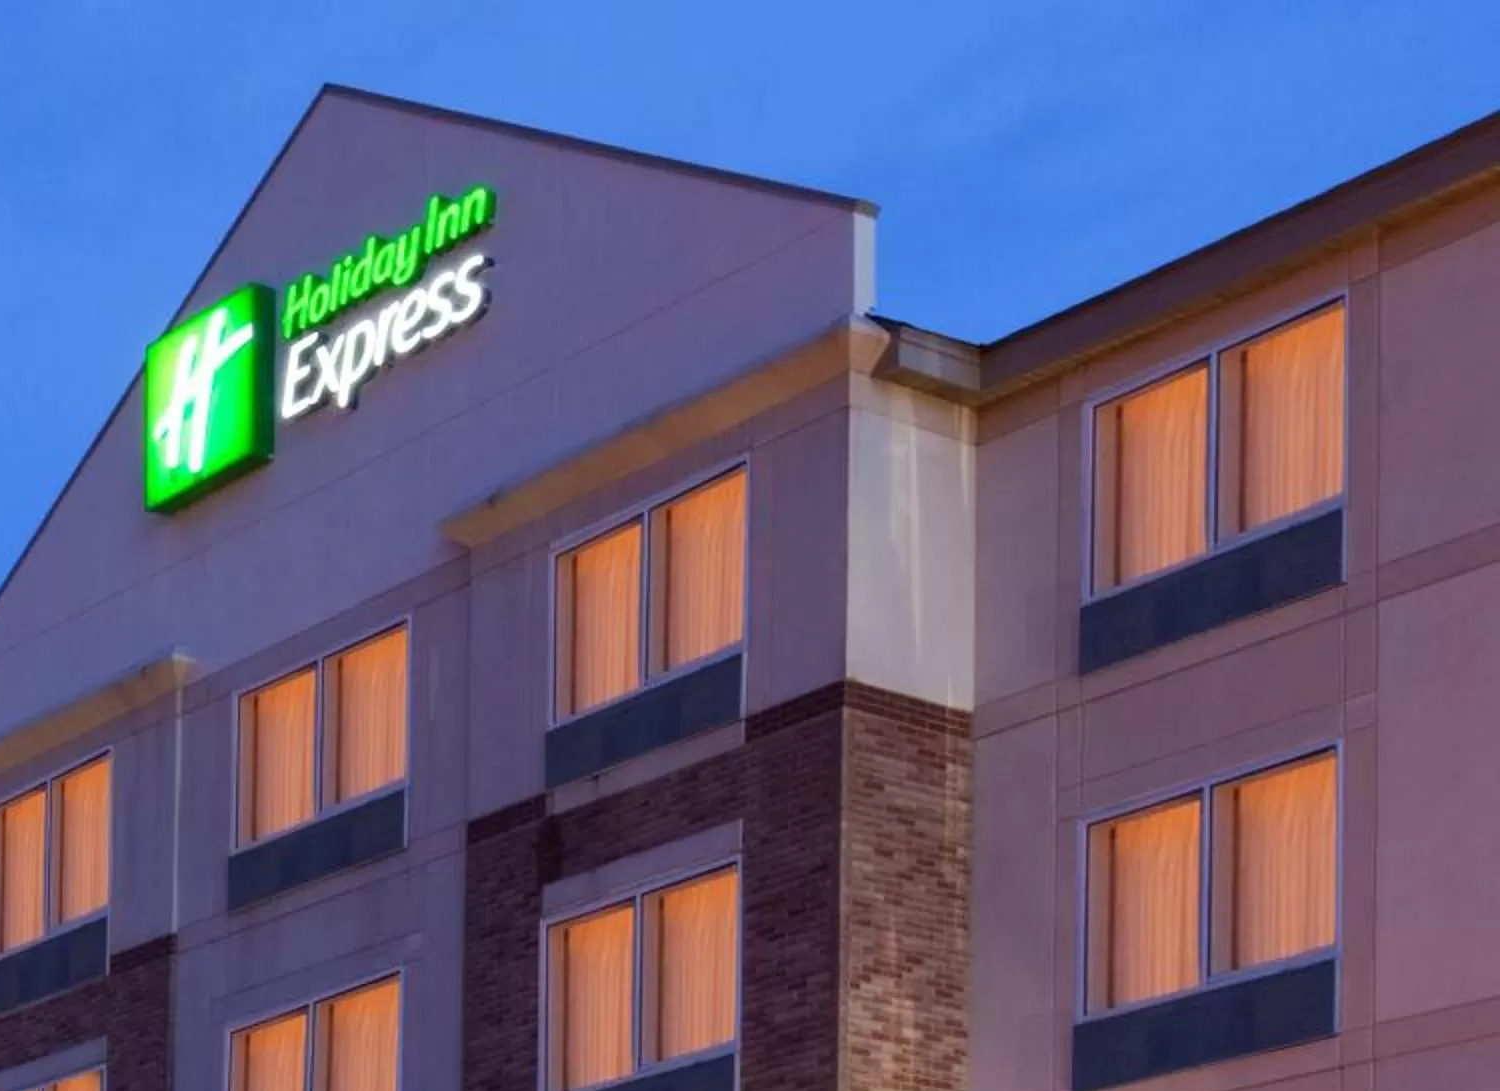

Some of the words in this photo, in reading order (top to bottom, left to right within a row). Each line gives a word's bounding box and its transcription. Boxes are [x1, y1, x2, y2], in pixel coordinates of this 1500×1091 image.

[281, 254, 488, 419] Express
[284, 226, 422, 339] Holiday
[423, 187, 493, 255] Inn
